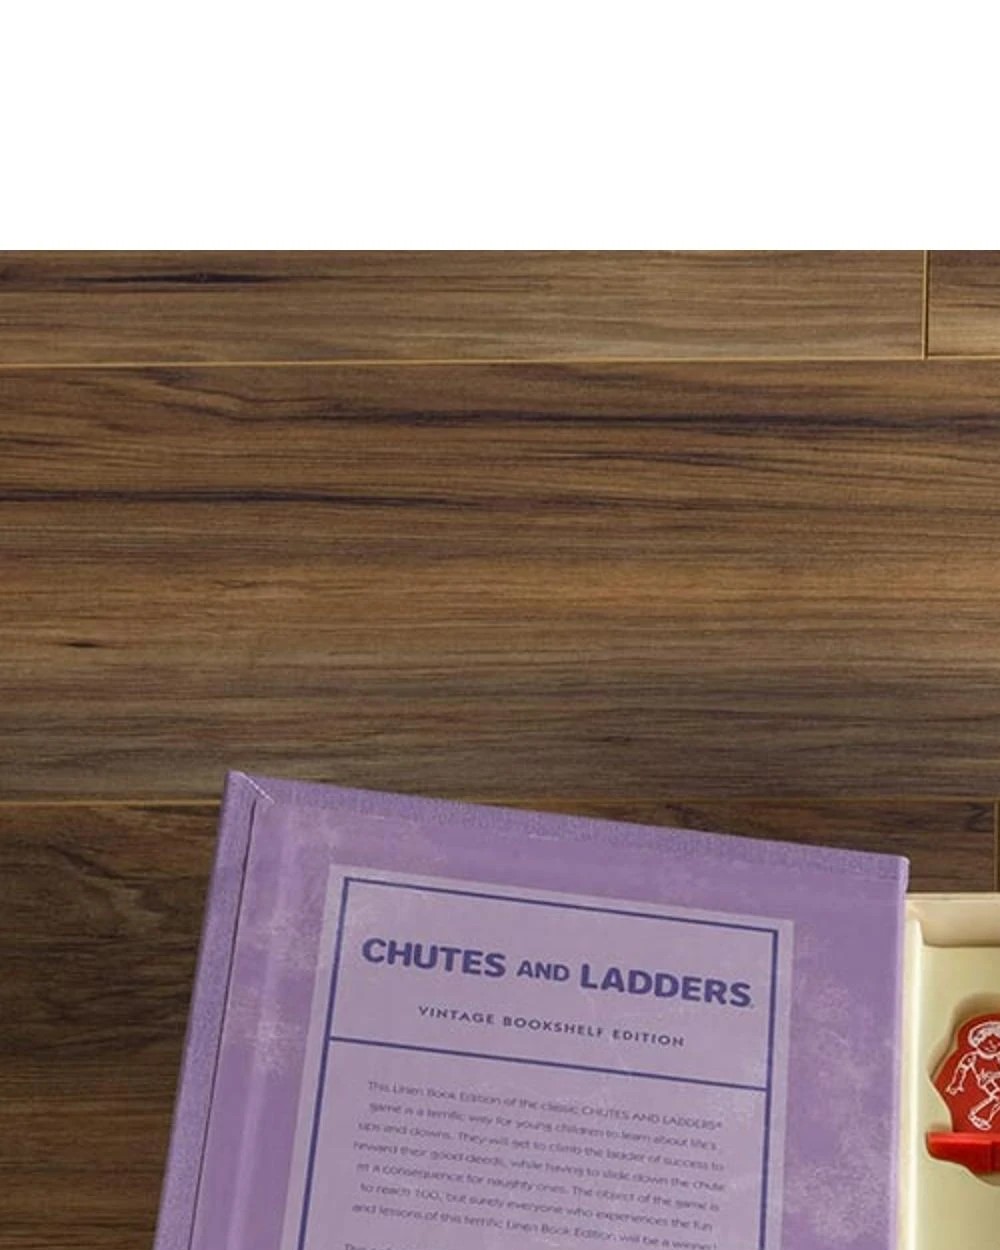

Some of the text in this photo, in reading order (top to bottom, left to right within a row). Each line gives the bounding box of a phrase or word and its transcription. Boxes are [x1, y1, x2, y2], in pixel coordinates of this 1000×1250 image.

[361, 937, 506, 977] CHUTES
[516, 959, 570, 982] AND
[418, 1005, 685, 1047] VINTAGE BOOKSHELF EDITION
[366, 1081, 390, 1093] This
[426, 1087, 456, 1100] Book
[502, 1096, 516, 1107] of
[518, 1098, 538, 1110] the
[580, 1105, 629, 1120] CHUTES
[630, 1111, 660, 1123] AND
[382, 1123, 406, 1134] and
[458, 1132, 486, 1146] They
[532, 1140, 546, 1150] to
[583, 1146, 604, 1156] the
[647, 1153, 662, 1163] of
[663, 1157, 708, 1168] success
[494, 1116, 512, 1126] for
[514, 1120, 552, 1133] young
[620, 1130, 650, 1141] learn
[652, 1133, 688, 1145] about
[429, 1149, 464, 1164] good
[586, 1167, 600, 1177] to
[631, 1172, 668, 1185] down
[670, 1176, 690, 1187] the
[465, 1173, 482, 1184] for
[571, 1185, 592, 1196] The
[636, 1193, 650, 1203] of
[652, 1194, 672, 1205] the
[423, 1210, 438, 1221] of
[439, 1212, 462, 1223] this
[540, 1223, 569, 1235] Book
[445, 1192, 466, 1203] but
[506, 1201, 562, 1216] everyone
[566, 1206, 592, 1217] who
[595, 1209, 668, 1228] experiences
[670, 1218, 690, 1228] the
[692, 1220, 713, 1231] fun
